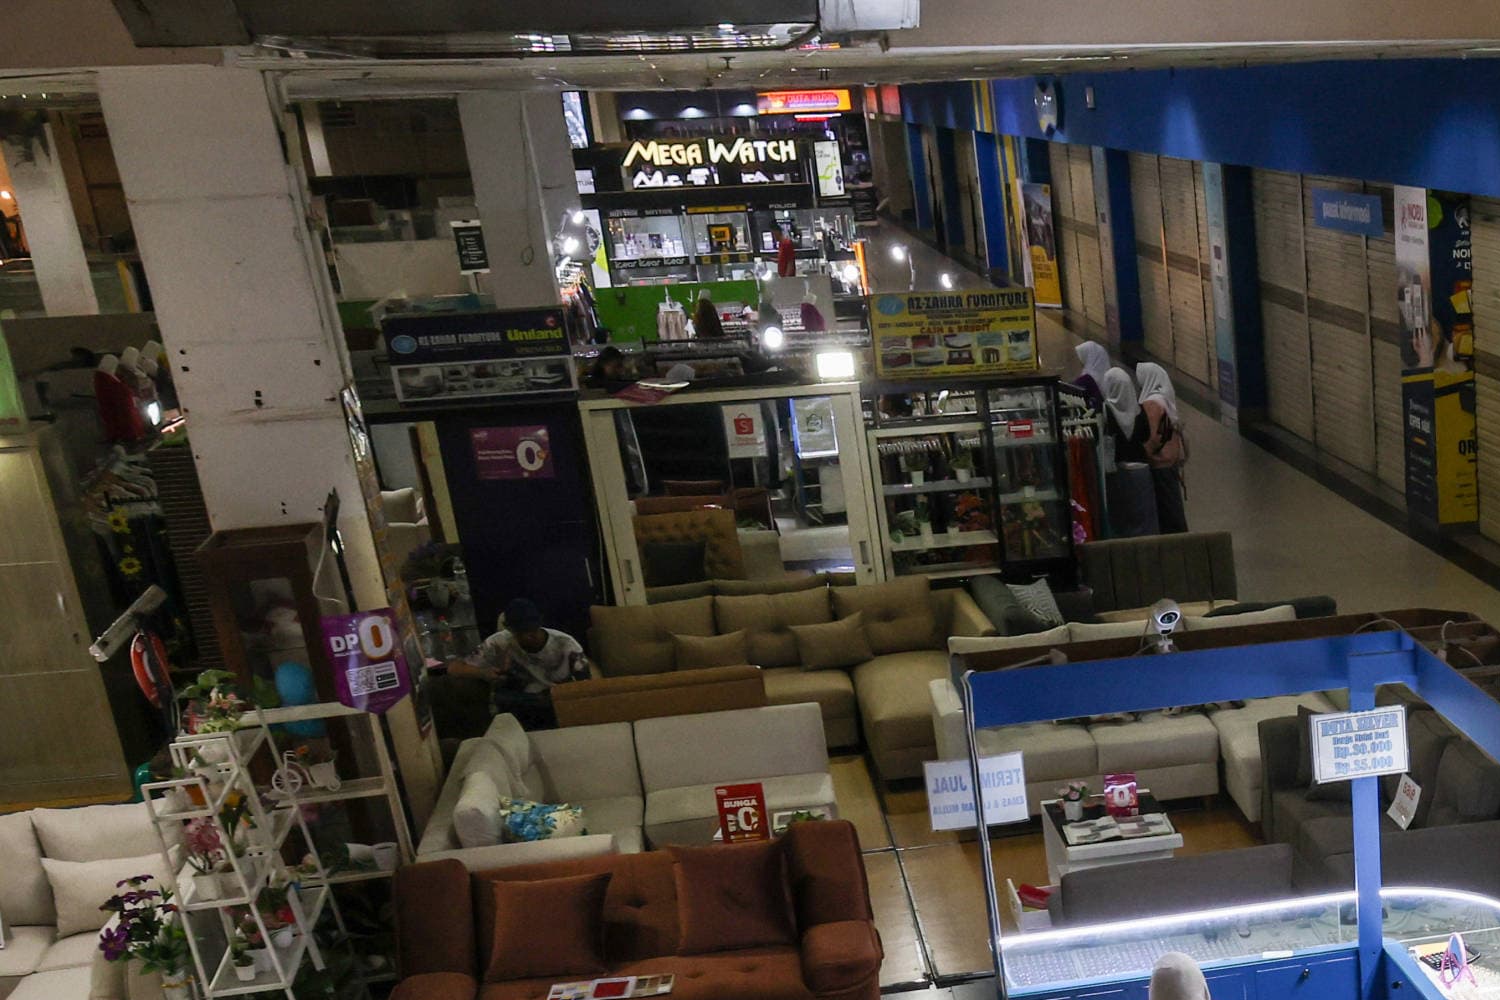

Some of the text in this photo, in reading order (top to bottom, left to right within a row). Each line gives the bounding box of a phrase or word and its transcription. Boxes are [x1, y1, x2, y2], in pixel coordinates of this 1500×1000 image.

[623, 137, 797, 167] MEGA WATCH
[966, 291, 1028, 308] FURNITURE
[507, 327, 564, 342] Uniland
[329, 634, 359, 653] DP
[1356, 712, 1399, 732] SILVER
[723, 798, 758, 809] BUNGA
